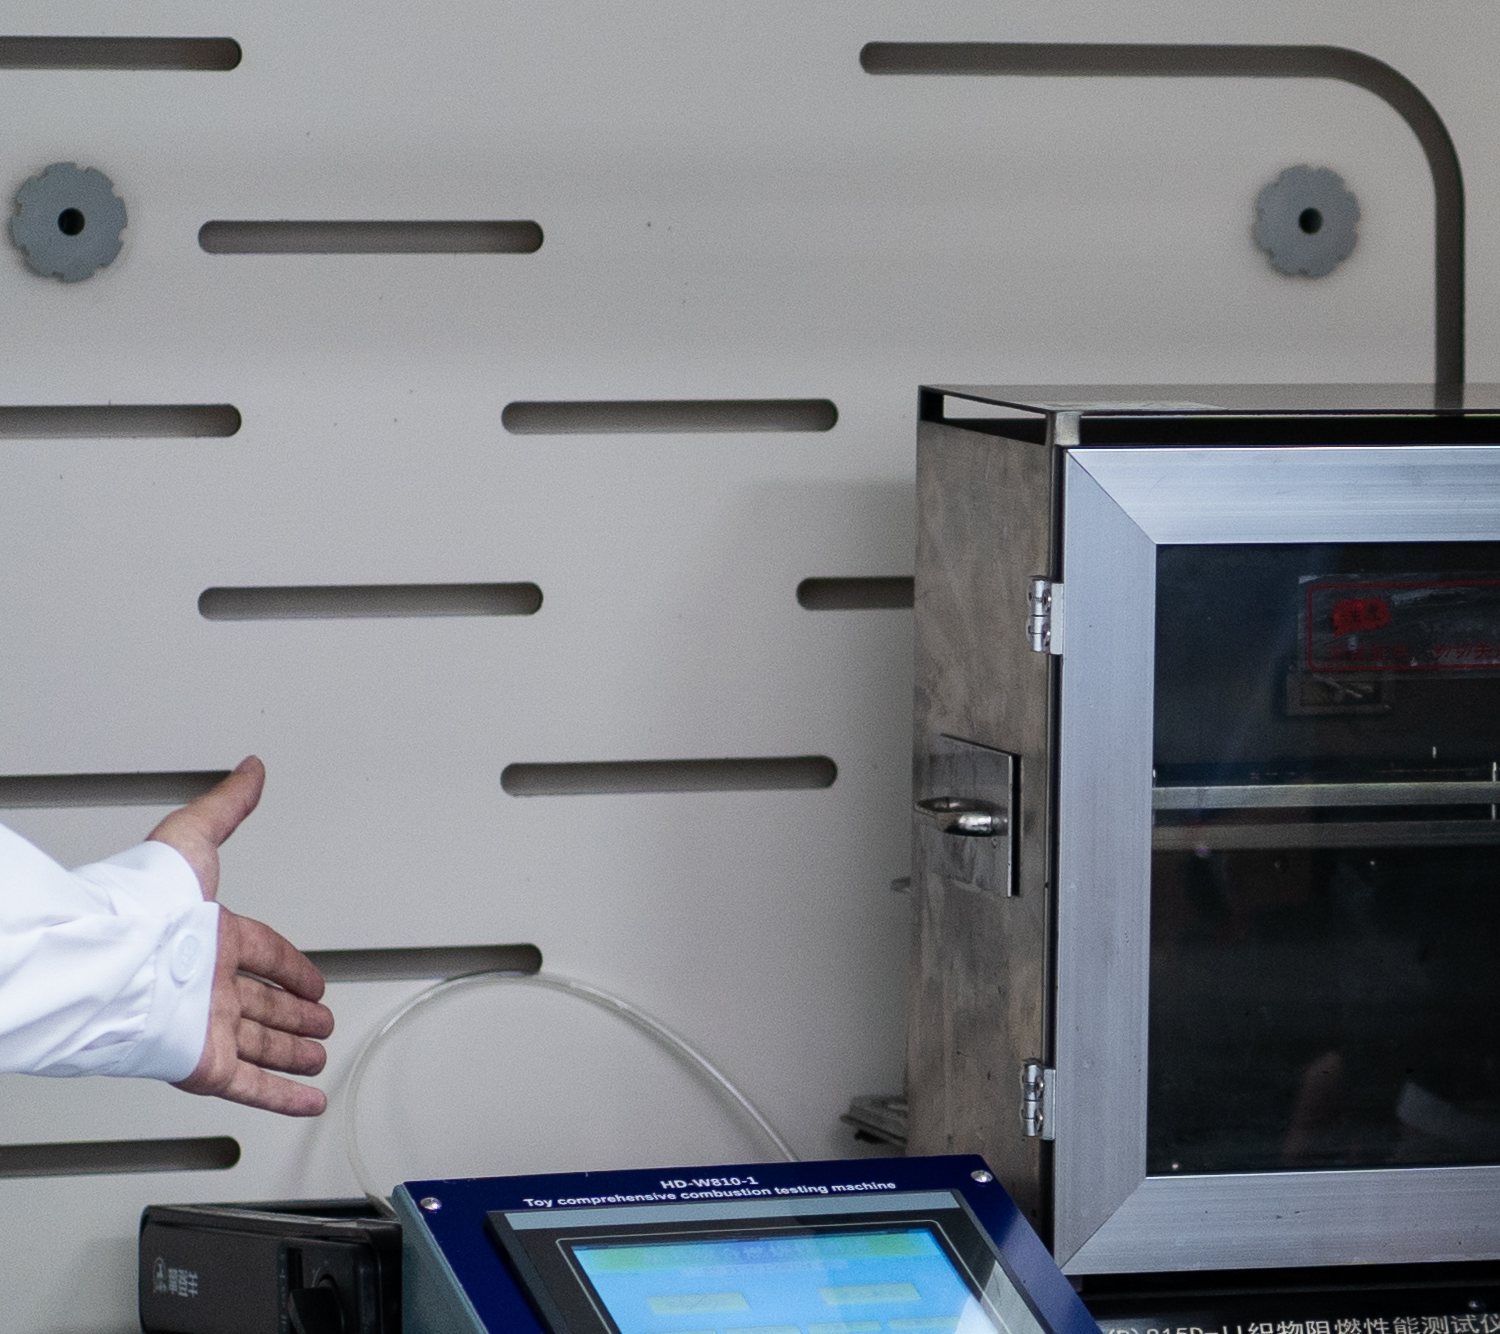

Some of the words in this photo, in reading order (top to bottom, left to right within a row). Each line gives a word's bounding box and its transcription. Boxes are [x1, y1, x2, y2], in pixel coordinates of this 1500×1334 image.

[660, 1176, 759, 1190] HD-W810-1
[523, 1197, 553, 1208] Toy
[557, 1192, 677, 1207] comprehensive
[680, 1187, 771, 1200] combustion
[774, 1183, 828, 1196] testing
[831, 1181, 896, 1192] machine
